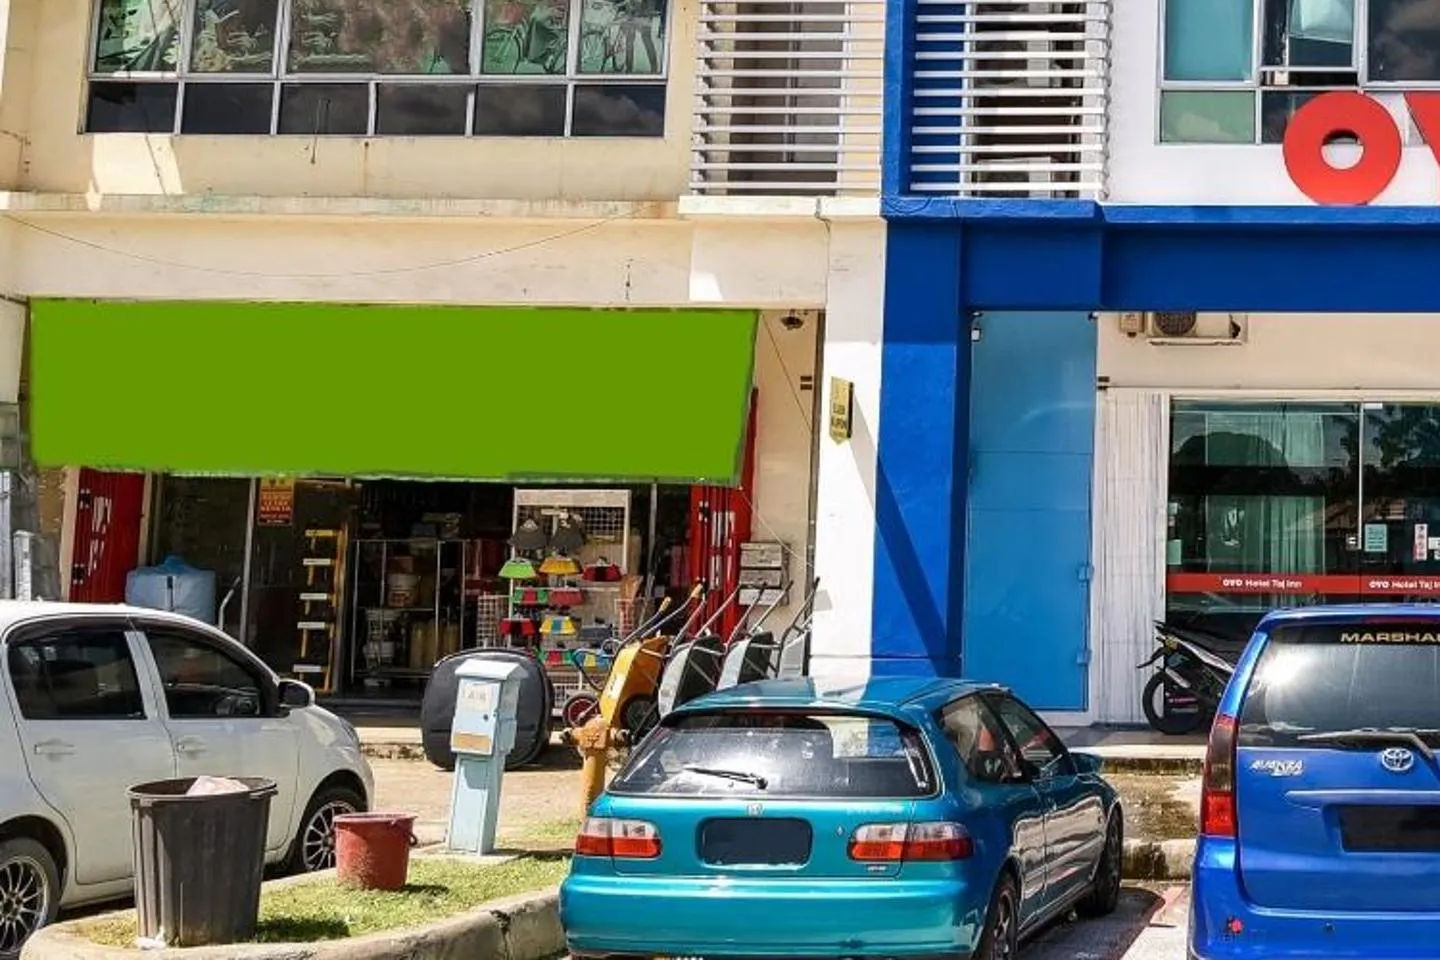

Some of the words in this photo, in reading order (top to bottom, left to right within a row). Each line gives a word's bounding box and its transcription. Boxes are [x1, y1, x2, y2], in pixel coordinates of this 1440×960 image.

[1222, 579, 1243, 589] OYO
[1245, 579, 1270, 589] Hotel
[1368, 580, 1389, 589] OYO
[1391, 580, 1417, 589] Hotel
